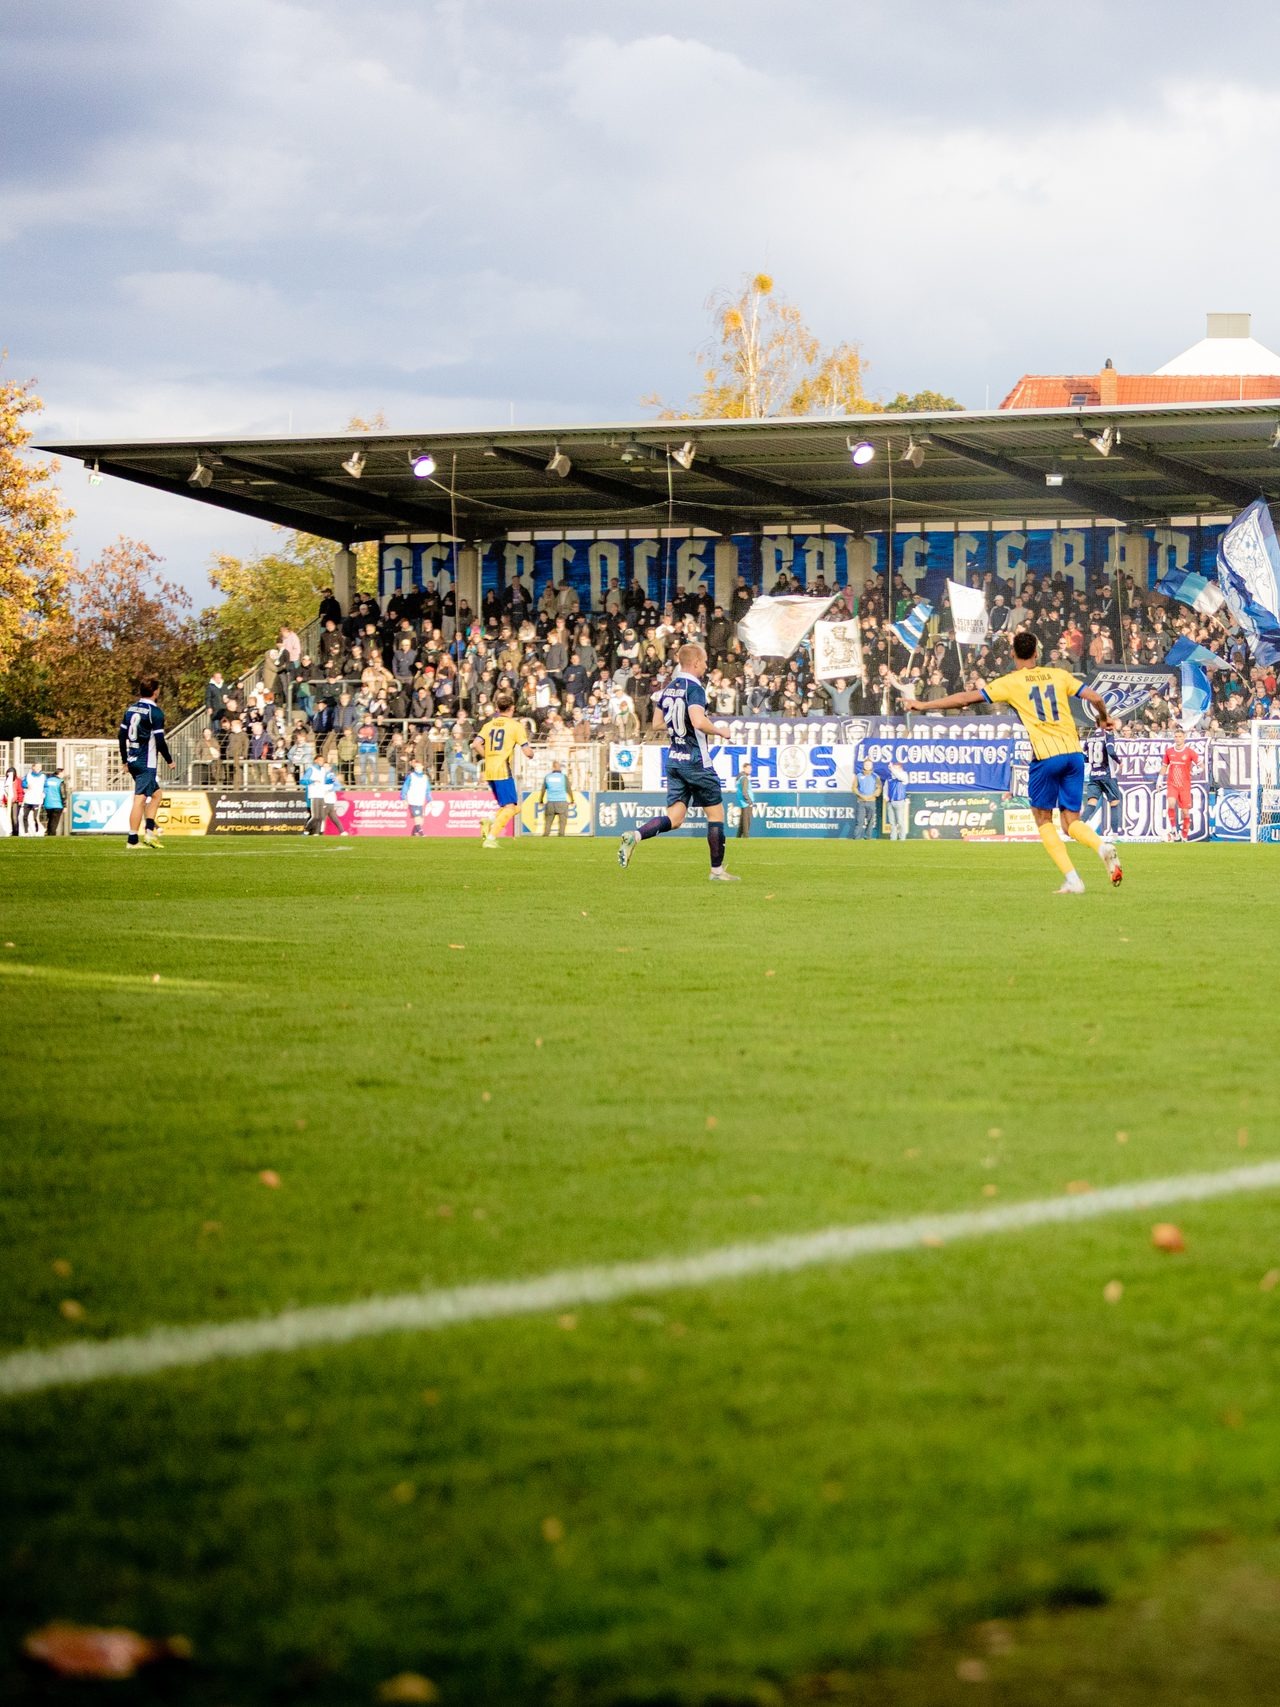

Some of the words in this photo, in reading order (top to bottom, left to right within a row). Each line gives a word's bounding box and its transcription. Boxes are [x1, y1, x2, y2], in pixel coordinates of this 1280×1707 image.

[1029, 684, 1060, 722] 11
[128, 713, 142, 742] 8
[662, 697, 687, 737] 20
[489, 729, 504, 751] 19
[857, 745, 892, 764] LOS
[895, 745, 1008, 764] CONSORTOS
[1087, 741, 1103, 763] 18
[73, 800, 117, 823] SAP
[449, 800, 498, 810] TAVERPAC
[752, 802, 855, 819] WESTMINSTER
[914, 810, 993, 826] Gabler
